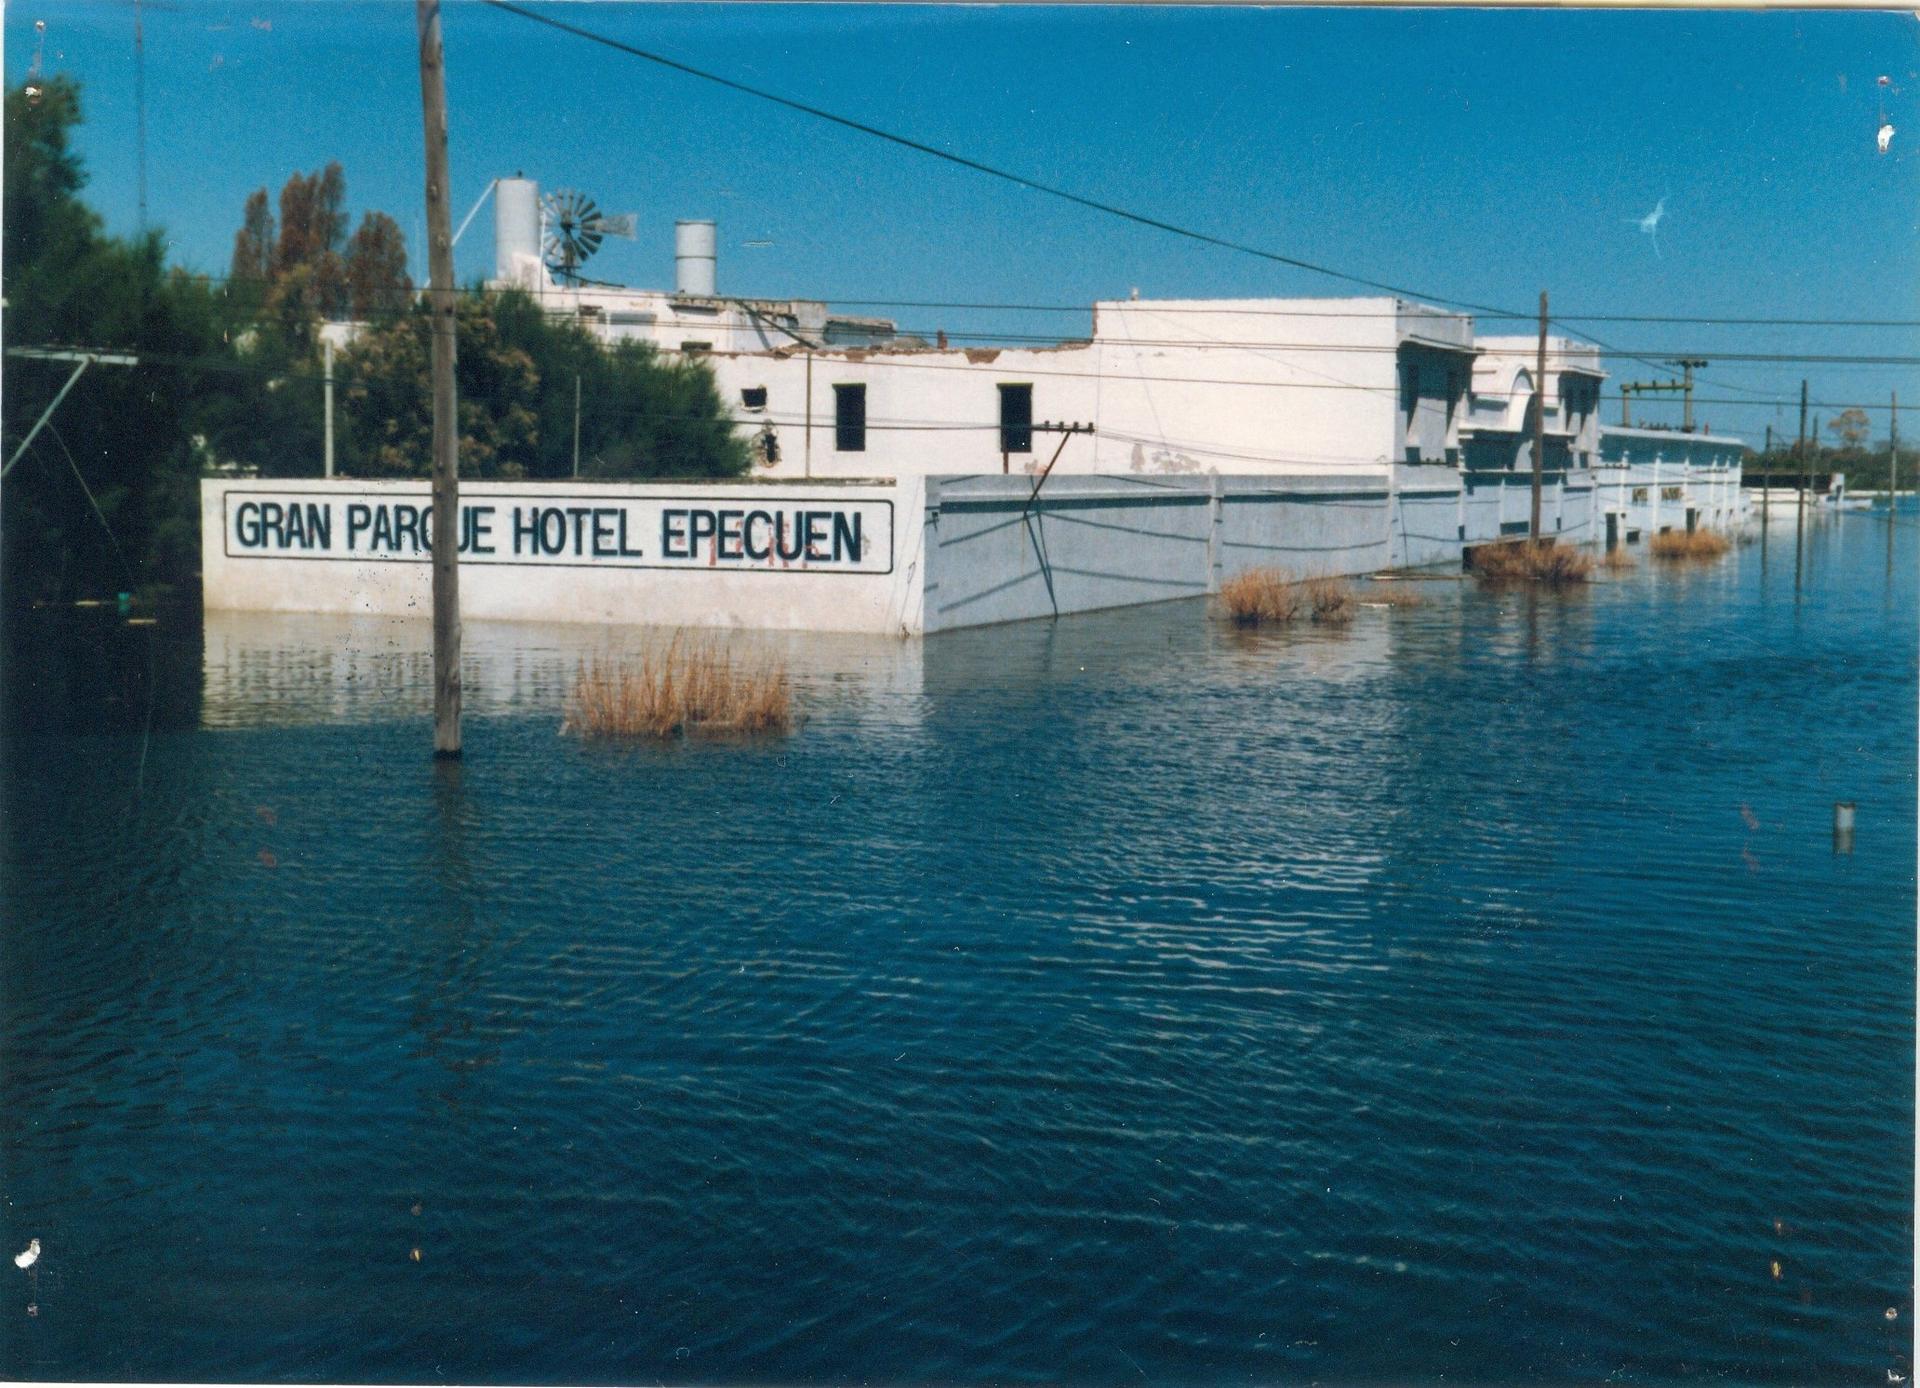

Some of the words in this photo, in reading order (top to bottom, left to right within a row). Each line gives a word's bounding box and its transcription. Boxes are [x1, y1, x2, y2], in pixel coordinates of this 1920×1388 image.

[236, 502, 331, 550] GRAN
[513, 507, 643, 557] HOTEL
[662, 508, 862, 562] EPECUEN
